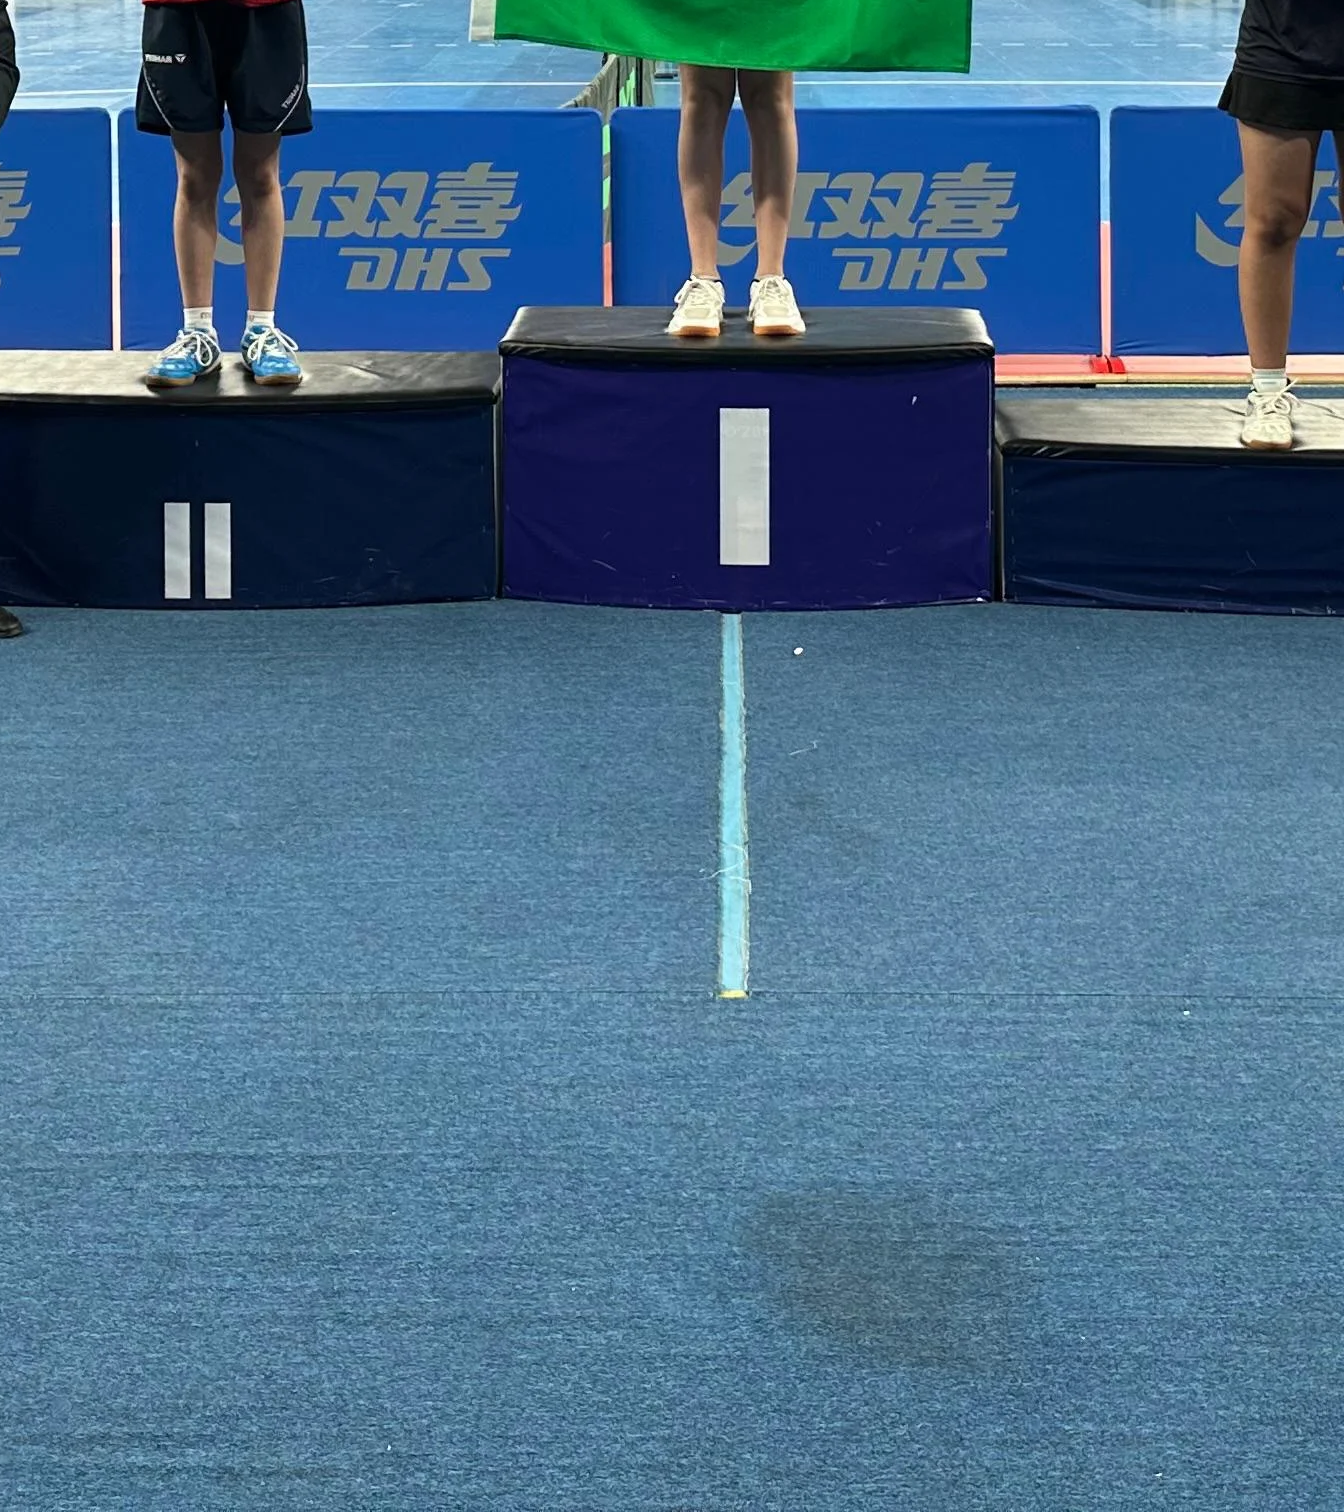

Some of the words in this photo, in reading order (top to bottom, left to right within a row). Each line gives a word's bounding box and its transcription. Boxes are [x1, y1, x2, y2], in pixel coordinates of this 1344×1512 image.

[338, 247, 512, 291] DHS
[831, 247, 1008, 290] DHS
[163, 502, 232, 600] II
